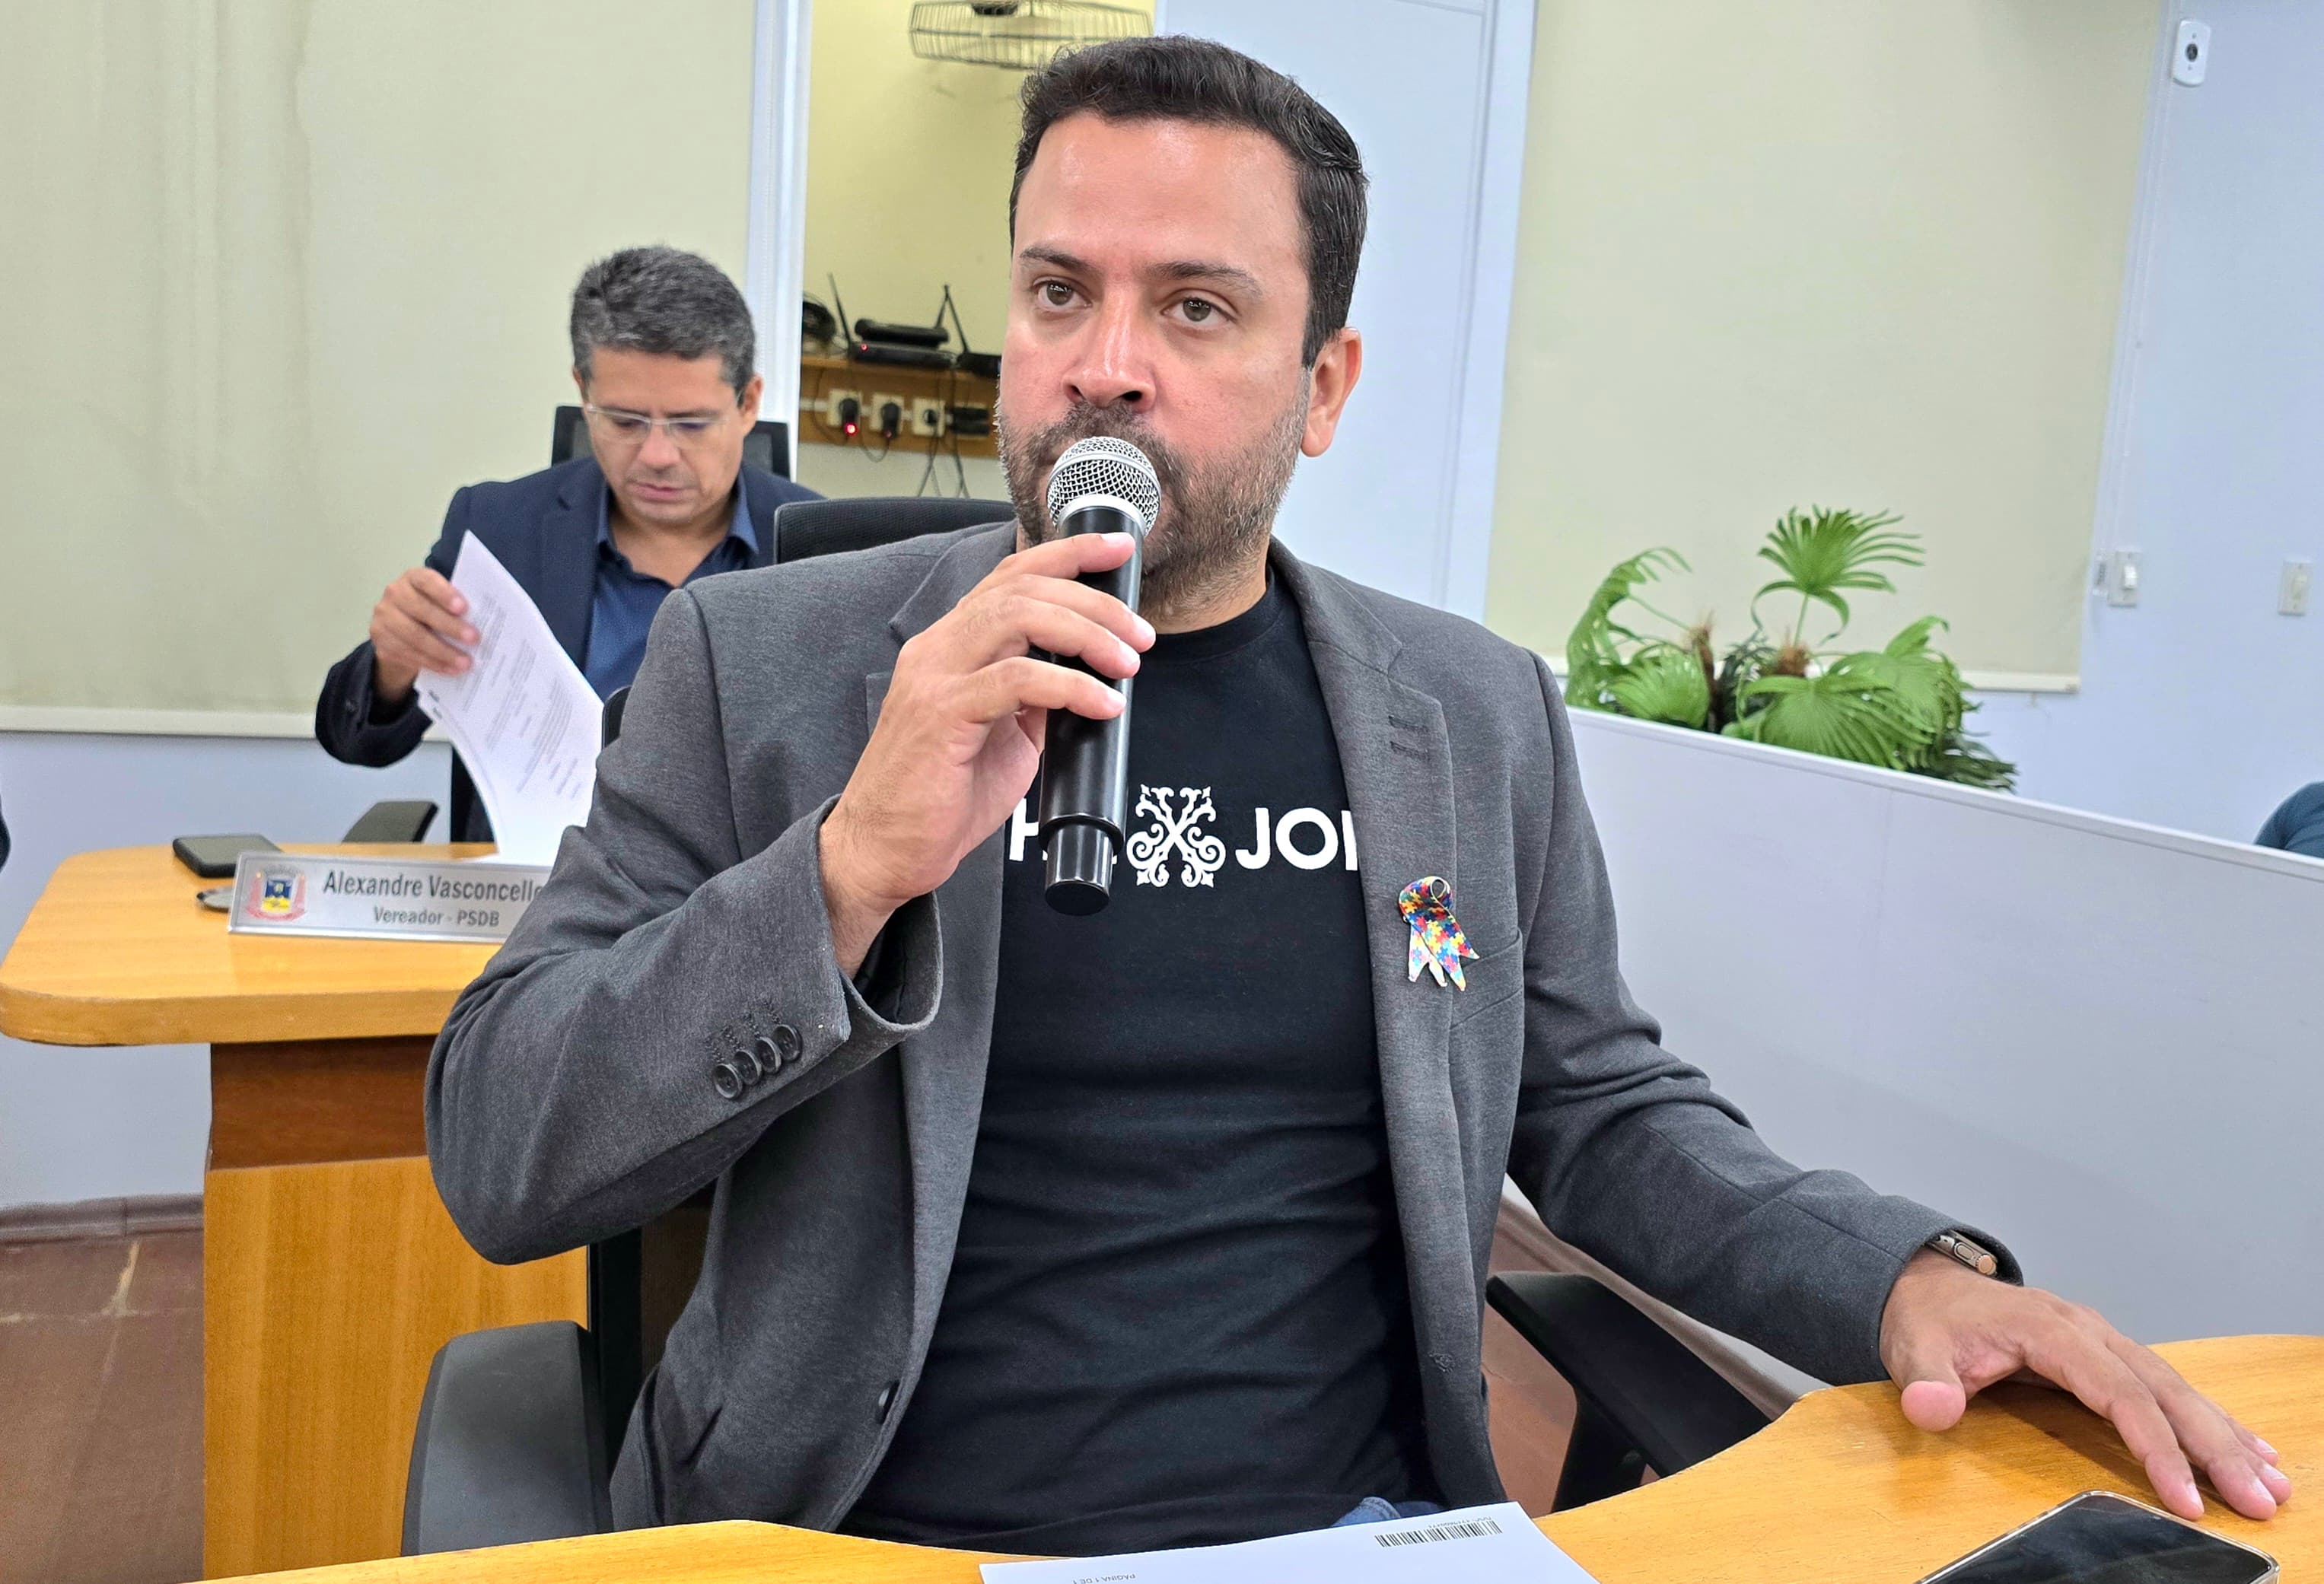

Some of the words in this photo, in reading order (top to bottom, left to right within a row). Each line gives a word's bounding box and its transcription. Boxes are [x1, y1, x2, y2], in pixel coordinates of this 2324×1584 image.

[323, 870, 422, 896] Alexandre
[374, 905, 444, 925] Vereador
[457, 909, 500, 926] PSDB
